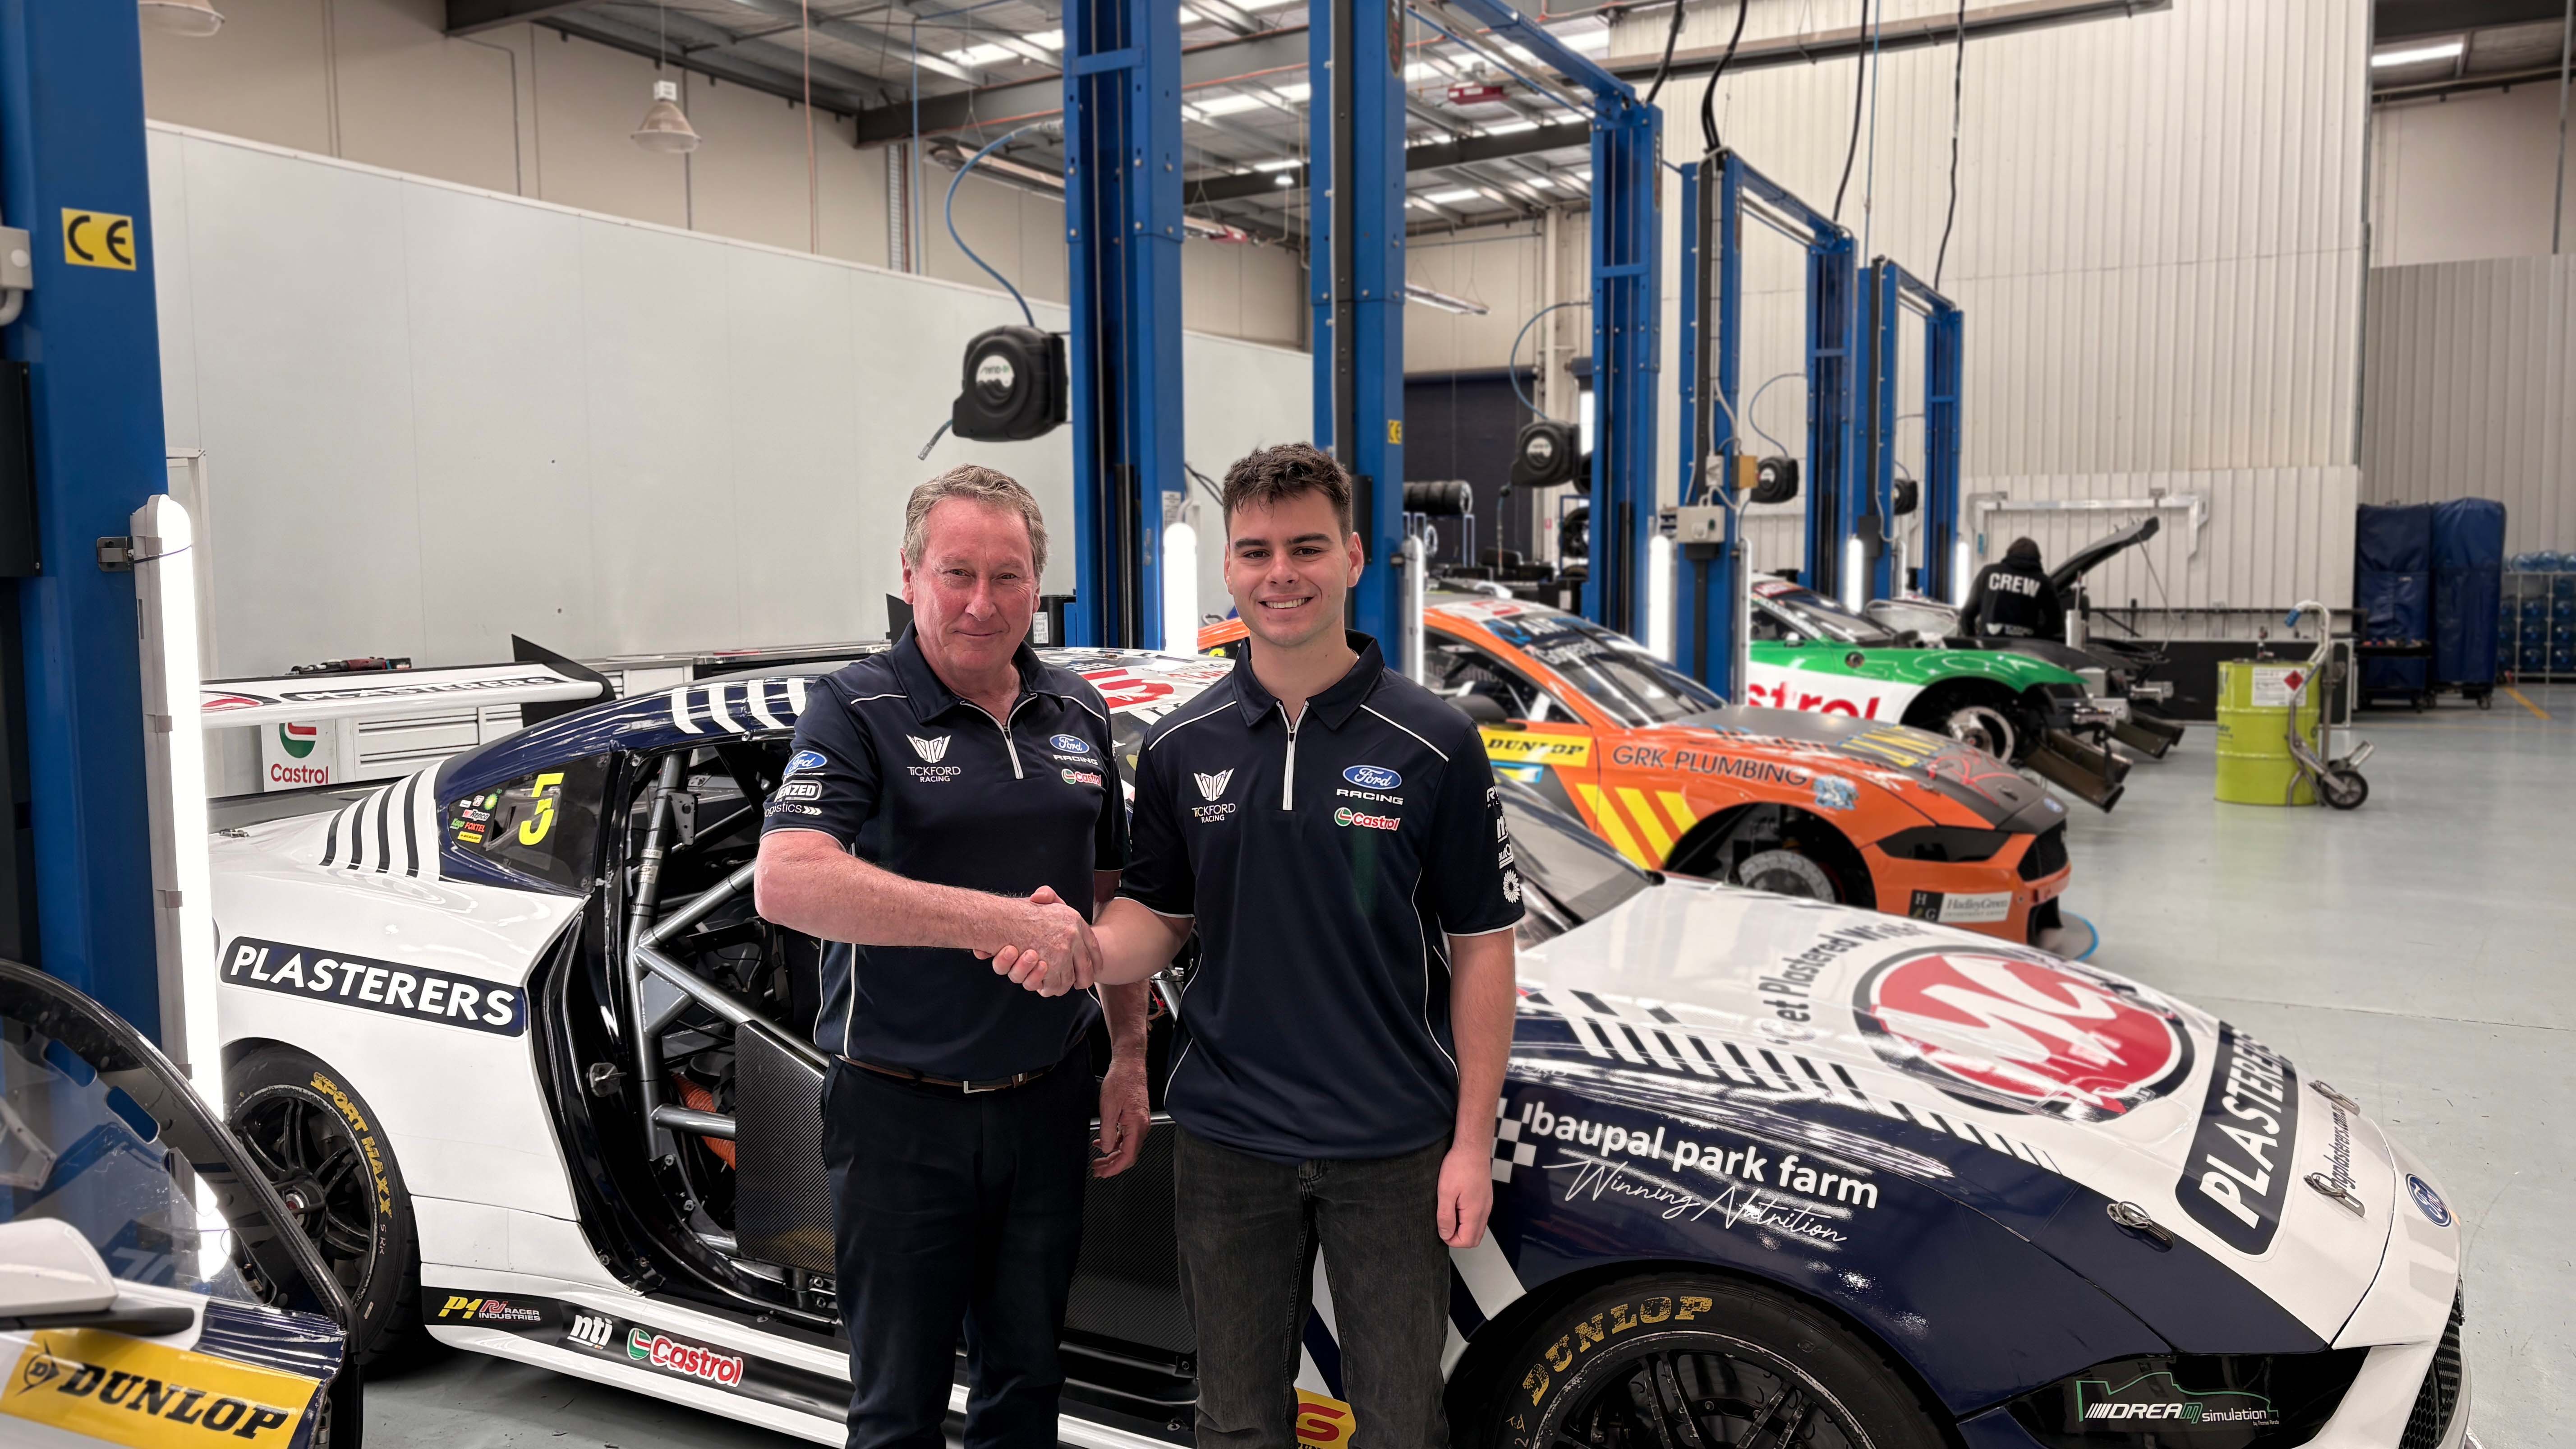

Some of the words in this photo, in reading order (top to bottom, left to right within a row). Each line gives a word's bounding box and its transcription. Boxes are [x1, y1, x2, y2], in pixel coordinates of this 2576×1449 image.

[68, 215, 132, 265] CE
[1989, 572, 2041, 598] CREW
[295, 678, 556, 701] PLASTERERS
[1058, 736, 1084, 751] Ford
[1053, 754, 1098, 766] RACING
[1613, 745, 1664, 769] GRK
[1674, 752, 1808, 786] PLUMBING
[271, 763, 329, 784] Castrol
[1074, 771, 1102, 787] Castrol
[1354, 768, 1392, 787] Ford
[519, 772, 564, 845] 5
[1336, 789, 1403, 805] RACING
[764, 801, 802, 817] ogistics
[1201, 814, 1225, 823] RACING
[465, 821, 485, 832] FOXTEL
[1352, 812, 1401, 831] Castrol
[1758, 934, 1862, 997] Plastered
[229, 945, 515, 1026] PLASTERERS
[310, 1072, 367, 1132] SPORT
[362, 1136, 392, 1219] MAXX
[1531, 1102, 1665, 1159] baupal
[1672, 1140, 1766, 1183] park
[1779, 1154, 1877, 1209] farm
[1542, 1161, 1701, 1221] Winning
[438, 1296, 483, 1319] P1
[479, 1312, 541, 1321] INDUSTRIES
[504, 1308, 540, 1316] RACER
[650, 1334, 743, 1386] Castrol
[1523, 1296, 1713, 1407] DUNLOP
[57, 1361, 289, 1440] DUNLOP
[2107, 1402, 2203, 1424] DREAM
[2201, 1407, 2267, 1421] simulation
